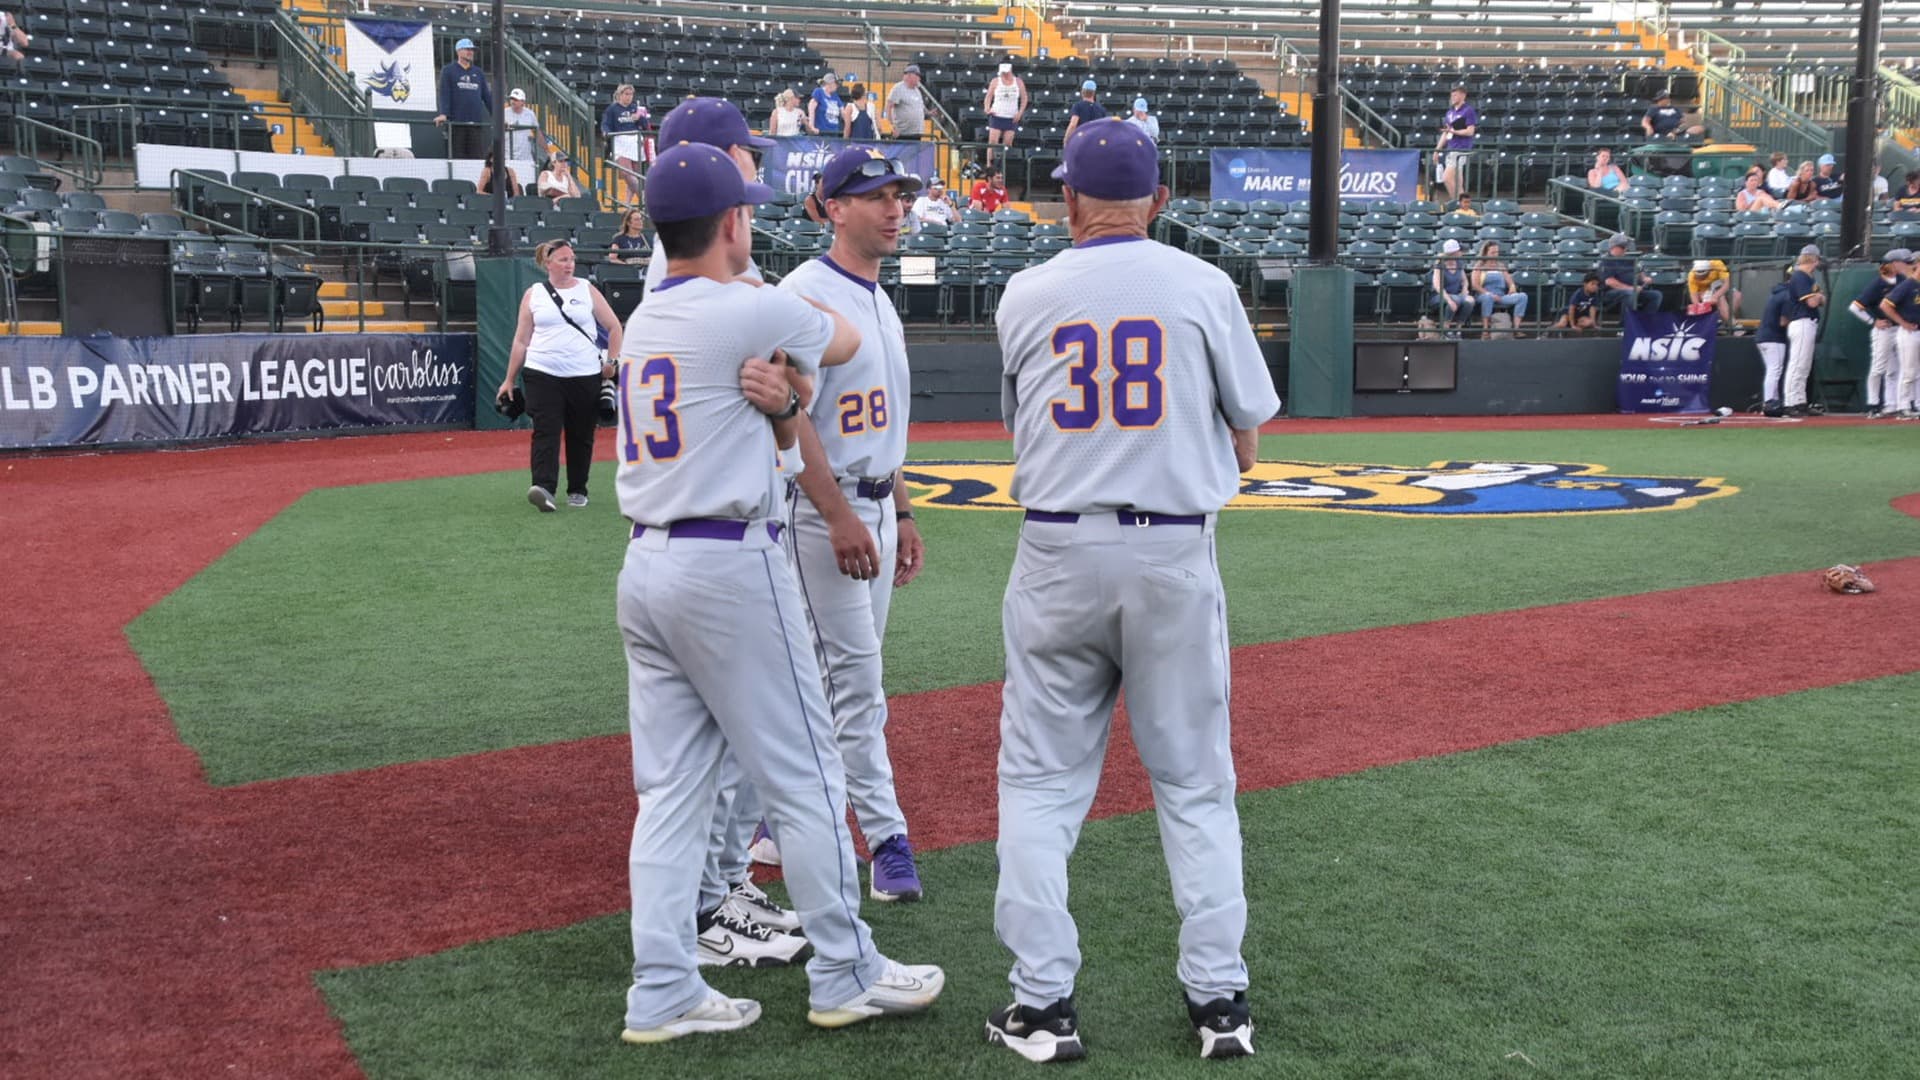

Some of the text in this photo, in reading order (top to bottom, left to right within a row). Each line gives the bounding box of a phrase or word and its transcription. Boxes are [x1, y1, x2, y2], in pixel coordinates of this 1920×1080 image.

[1243, 175, 1294, 192] MAKE
[1628, 331, 1706, 361] NSIC
[0, 366, 57, 410] LB
[67, 362, 233, 409] PARTNER
[241, 358, 368, 401] LEAGUE
[1049, 316, 1167, 432] 38
[618, 353, 683, 465] 13
[839, 386, 890, 437] 28
